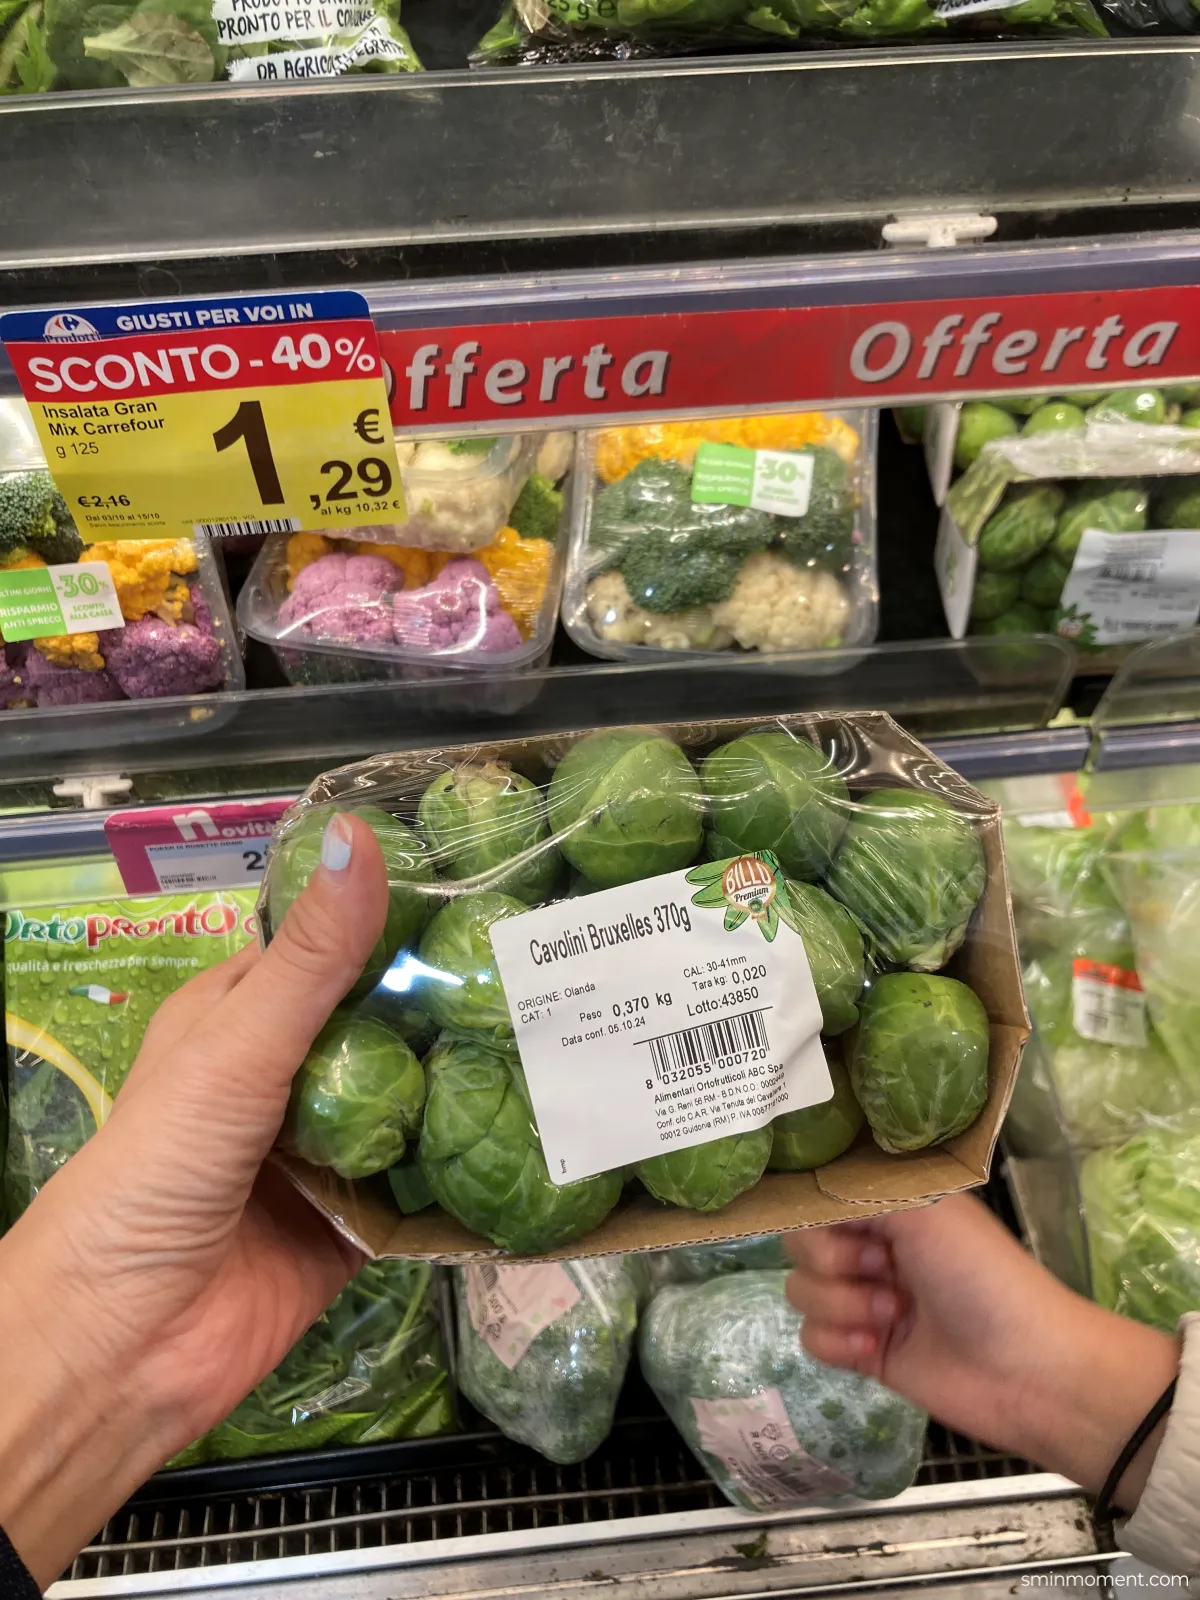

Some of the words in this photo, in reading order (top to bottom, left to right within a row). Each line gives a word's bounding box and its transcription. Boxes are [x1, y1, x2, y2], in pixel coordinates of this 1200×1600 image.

[217, 12, 281, 39] PRONTO
[284, 10, 315, 29] PER
[318, 9, 332, 28] IL
[256, 63, 277, 80] DA
[116, 311, 192, 332] GIUSTI
[197, 307, 240, 325] PER
[243, 305, 284, 323] VOI
[288, 303, 314, 319] IN
[850, 312, 1179, 384] Offerta
[28, 343, 240, 393] SCONTO
[381, 340, 669, 410] fferta
[42, 404, 110, 419] Insalata
[114, 401, 157, 416] Gran
[48, 422, 79, 437] Mix
[83, 418, 165, 436] Carrefour
[353, 408, 385, 445] €
[55, 445, 67, 459] g
[71, 441, 99, 456] 125
[213, 400, 286, 505] 1
[102, 513, 125, 521] 03/10
[137, 511, 160, 520] 15/10
[321, 508, 332, 516] al
[336, 505, 351, 516] kg
[356, 500, 389, 513] 10,32
[392, 500, 400, 510] €
[0, 588, 22, 598] LTIMI
[24, 586, 51, 596] GIORNI
[0, 602, 58, 618] RISPARMIO
[3, 620, 25, 630] ANTI
[27, 616, 61, 627] SPRECO
[734, 887, 769, 903] Premium
[530, 926, 588, 966] Cavolini
[587, 911, 653, 950] Bruxelles
[653, 901, 692, 933] 370g
[6, 959, 49, 978] qualità
[53, 962, 60, 972] e
[63, 957, 126, 973] freschezza
[127, 956, 147, 974] per
[151, 953, 199, 971] sempre
[683, 965, 706, 978] CAL:
[706, 955, 747, 973] 30-41mm
[692, 978, 713, 991] Tara
[714, 974, 728, 988] kg:
[732, 964, 767, 985] 0,020
[517, 991, 563, 1011] ORIGINE:
[564, 981, 596, 998] Olanda
[579, 1009, 602, 1022] Peso
[612, 996, 650, 1018] 0,370
[656, 991, 673, 1006] kg
[687, 985, 760, 1017] Lotto:43850
[521, 1010, 544, 1024] CAT:
[546, 1007, 551, 1017] 1
[561, 1034, 583, 1047] Data
[585, 1026, 607, 1041] conf.
[608, 1015, 646, 1034] 05.10.24
[645, 1078, 653, 1089] 8
[662, 1063, 712, 1085] 032055
[718, 1048, 767, 1069] 000720
[654, 1085, 696, 1104] Alimentari
[696, 1072, 746, 1091] Ortofrutticoli
[748, 1065, 766, 1078] ABC
[768, 1063, 784, 1074] Spa
[655, 1108, 667, 1118] Via
[668, 1105, 677, 1113] G.
[677, 1101, 694, 1111] Reni
[704, 1093, 716, 1104] RM
[656, 1118, 675, 1129] Conf.
[676, 1114, 686, 1124] c/o
[709, 1104, 721, 1114] Via
[722, 1098, 745, 1111] Tenuta
[660, 1128, 681, 1141] 00012
[682, 1121, 711, 1135] Guidonia
[713, 1114, 731, 1127] (RM)
[731, 1112, 739, 1121] P.
[739, 1109, 752, 1119] IVA
